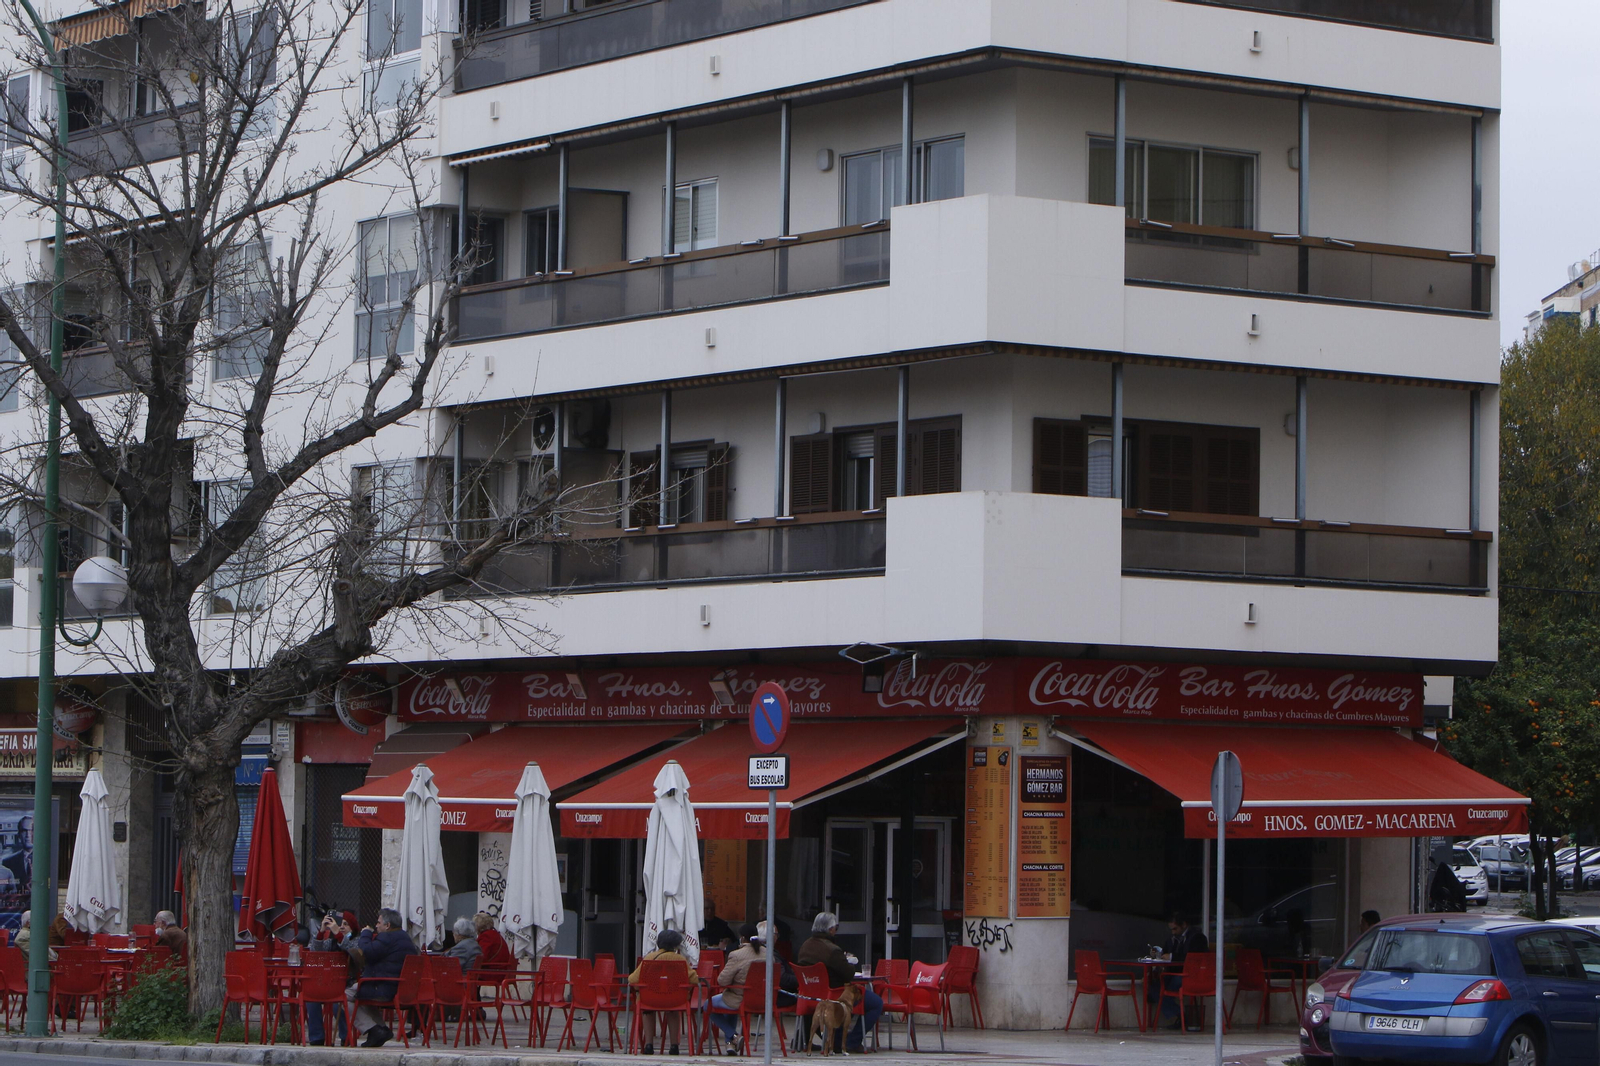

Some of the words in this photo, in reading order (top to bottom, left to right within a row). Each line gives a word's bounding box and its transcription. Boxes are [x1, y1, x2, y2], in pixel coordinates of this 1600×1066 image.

[597, 672, 693, 697] Hnos.
[1028, 661, 1167, 709] Coca-Cola
[1179, 666, 1236, 697] Bar
[1243, 669, 1320, 700] Hnos.
[1327, 673, 1415, 711] Gómez
[409, 675, 497, 715] CocaCola
[527, 701, 586, 718] Especialidad
[590, 706, 603, 716] en
[607, 702, 646, 718] gambas
[650, 705, 656, 717] y
[659, 701, 706, 716] chacinas
[710, 700, 722, 715] de
[1180, 704, 1229, 716] Especialidad
[1229, 708, 1239, 716] en
[1243, 708, 1277, 719] gambas
[1279, 711, 1284, 720] y
[1285, 709, 1323, 720] chacinas
[1323, 710, 1334, 720] de
[1335, 711, 1373, 721] Cumbres
[1374, 713, 1410, 723] Mayores
[756, 760, 779, 769] EXCEPTO
[750, 775, 760, 784] BUS
[761, 774, 784, 785] ESCOLAR
[1026, 768, 1064, 780] HERMANOS
[1027, 781, 1049, 793] GÓMEZ
[1049, 782, 1063, 793] BAR
[495, 808, 516, 818] Cruzcam
[745, 812, 769, 823] Cruzcam
[1467, 808, 1509, 820] Cruzcampo
[1264, 815, 1308, 831] HNOS.
[1314, 814, 1365, 831] GOMEZ
[1375, 813, 1456, 830] MACARENA
[1376, 1017, 1398, 1028] 9646
[1401, 1018, 1420, 1029] CLH
